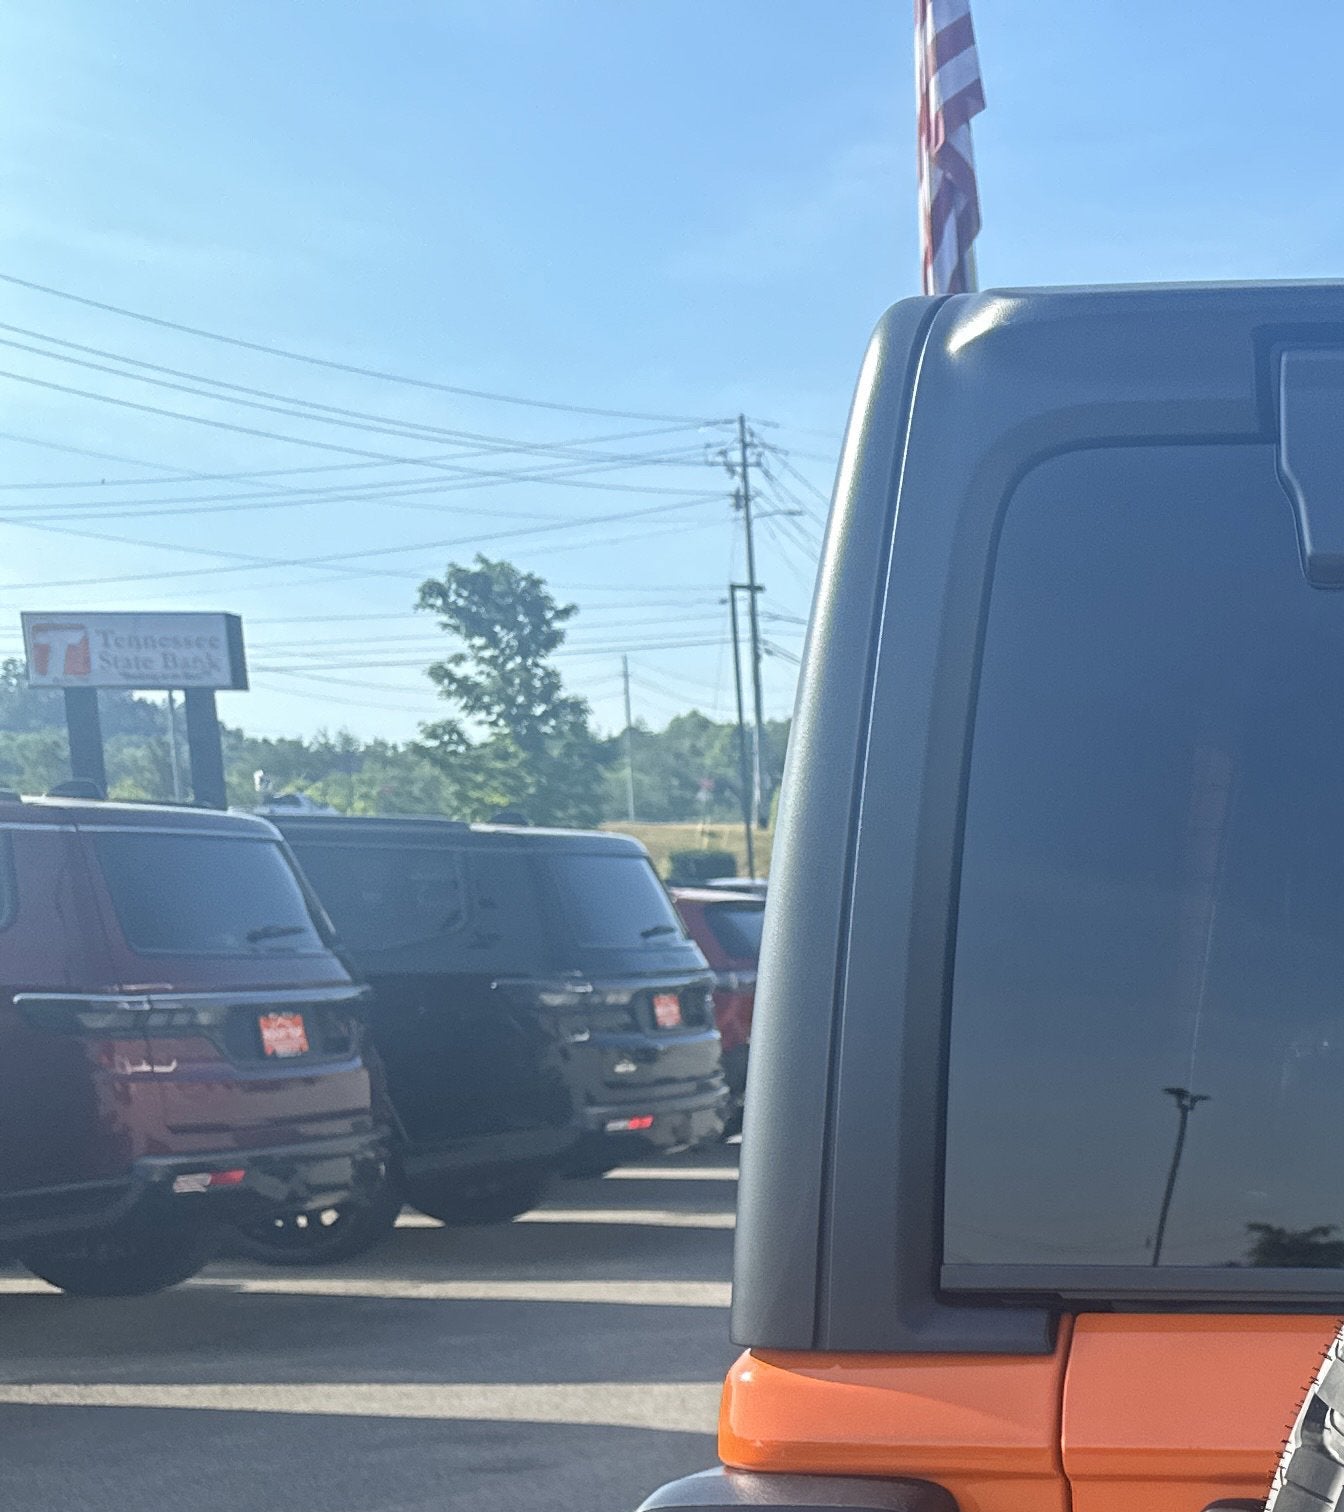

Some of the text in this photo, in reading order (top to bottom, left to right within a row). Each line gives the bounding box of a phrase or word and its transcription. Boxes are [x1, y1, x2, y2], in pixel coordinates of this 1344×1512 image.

[95, 629, 221, 650] Tennessee
[98, 652, 221, 672] State Bank
